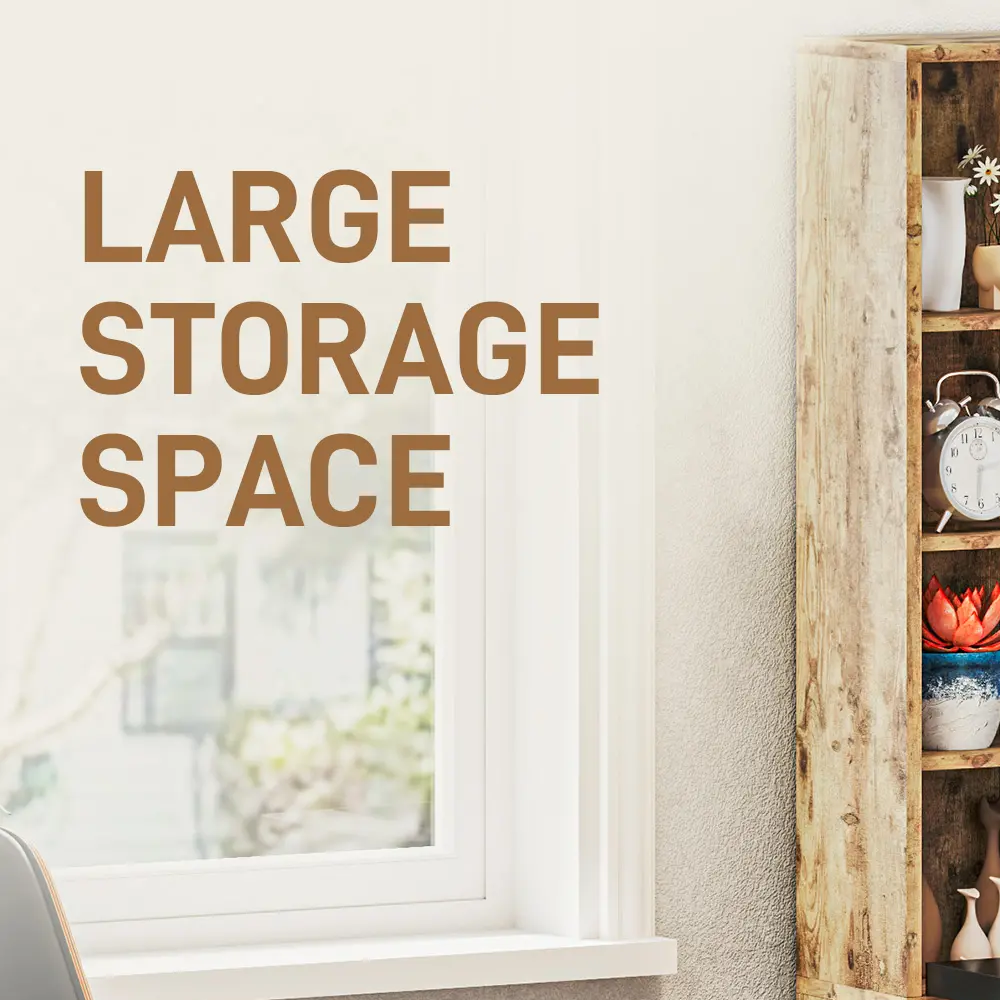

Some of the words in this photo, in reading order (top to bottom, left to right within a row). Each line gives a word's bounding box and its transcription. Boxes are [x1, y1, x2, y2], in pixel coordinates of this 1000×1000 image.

[974, 428, 982, 438] 12
[962, 434, 968, 444] 11
[951, 447, 958, 457] 10
[946, 466, 951, 476] 9
[951, 483, 956, 492] 8
[964, 495, 968, 505] 7
[978, 498, 984, 509] 6
